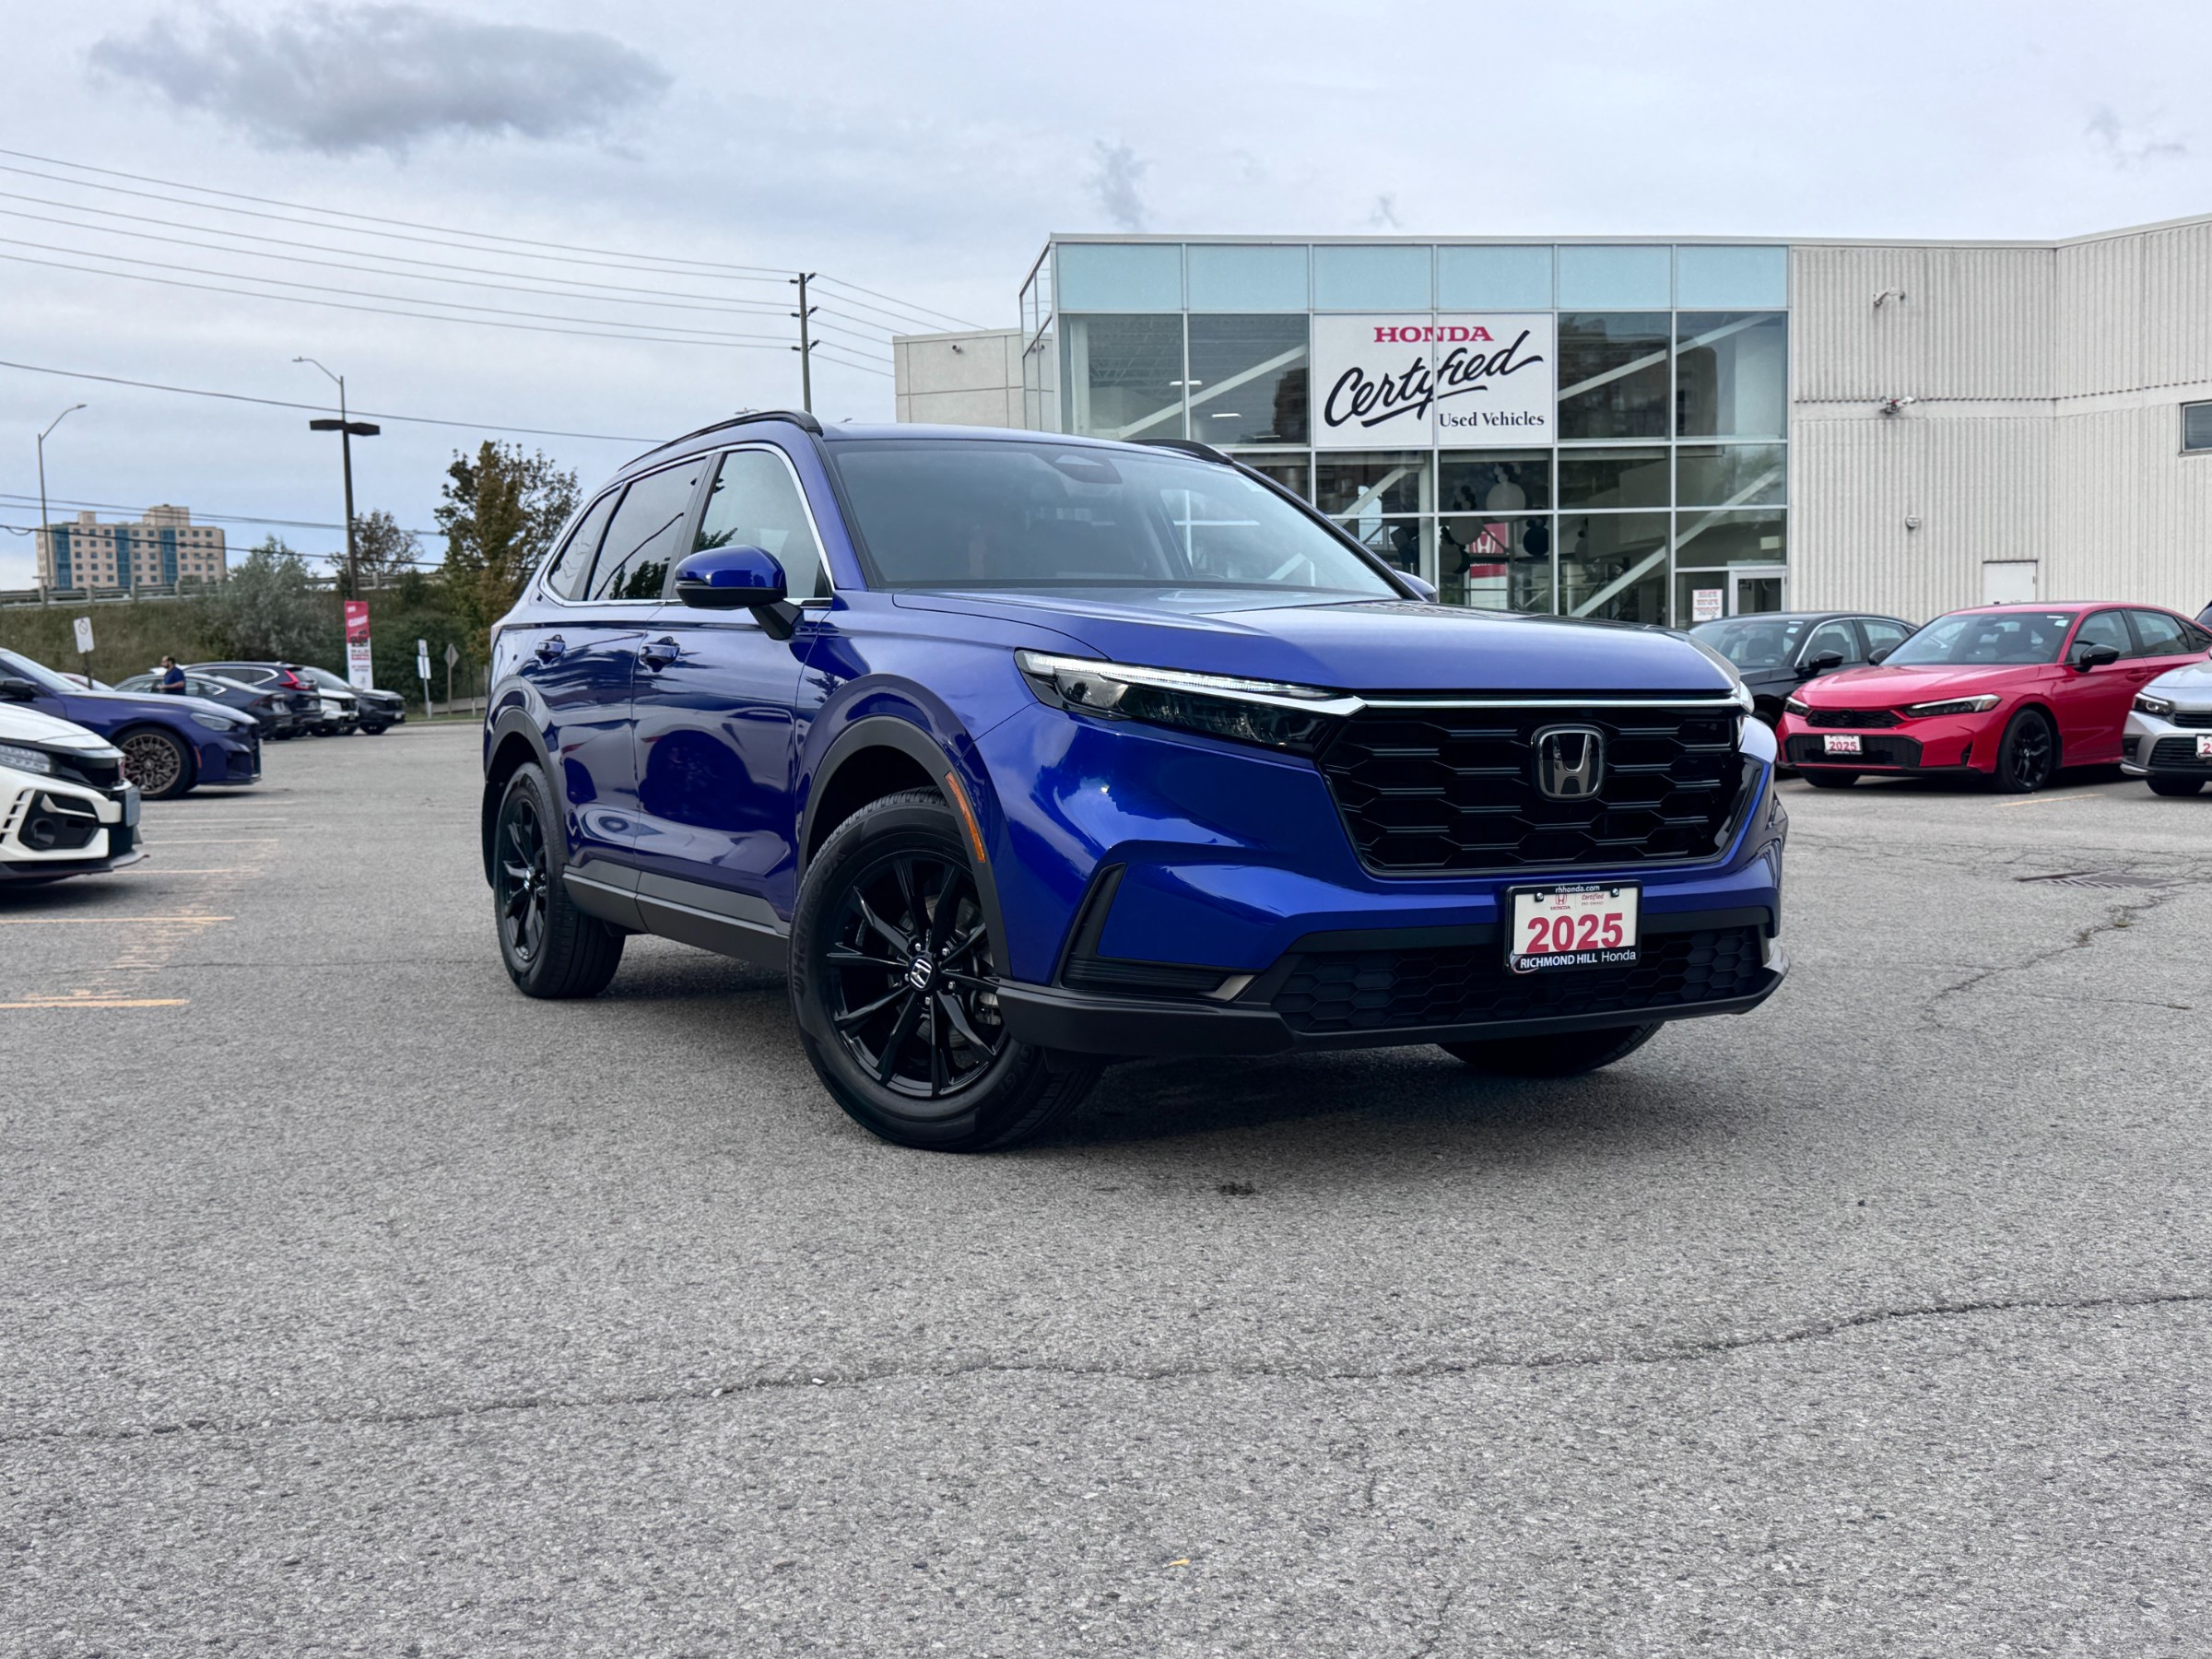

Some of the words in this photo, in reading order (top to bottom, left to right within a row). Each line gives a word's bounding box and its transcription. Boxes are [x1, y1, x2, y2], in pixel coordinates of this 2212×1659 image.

[1373, 325, 1494, 343] HONDA
[1324, 329, 1544, 428] Certified
[1439, 413, 1477, 427] Used
[1482, 411, 1545, 427] Vehicles
[1830, 741, 1857, 751] 2025
[1555, 885, 1600, 894] rhhonda.com
[1526, 912, 1623, 953] 2025
[1520, 954, 1575, 969] RICHMOND
[1577, 952, 1598, 965] HILL
[1602, 949, 1636, 962] Honda
